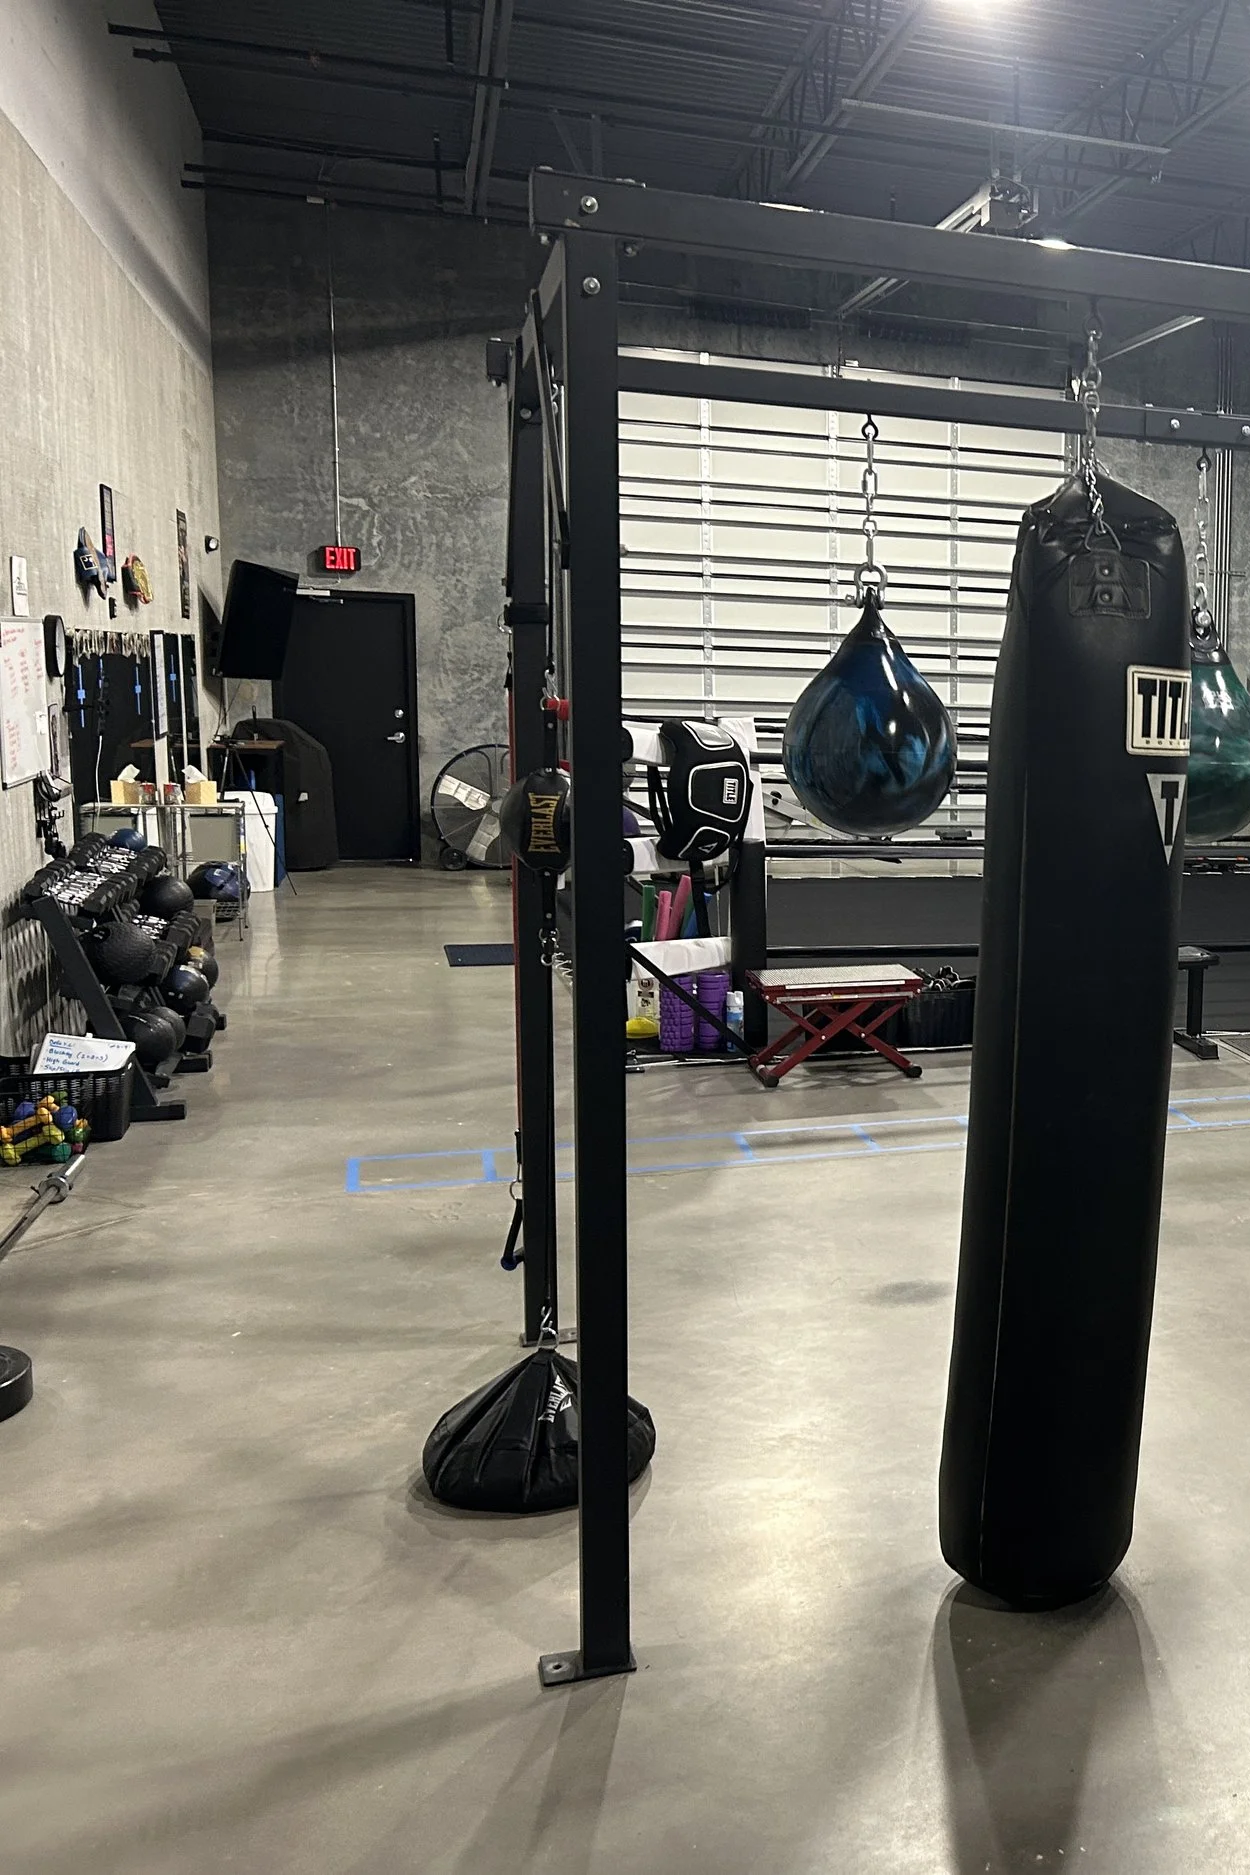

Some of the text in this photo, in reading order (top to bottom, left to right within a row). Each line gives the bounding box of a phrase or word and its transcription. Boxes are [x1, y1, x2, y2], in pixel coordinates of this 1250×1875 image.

[325, 547, 356, 570] EXIT
[1137, 677, 1190, 740] TITL
[528, 791, 562, 854] EVERLAST
[725, 781, 736, 802] TITLE
[1161, 780, 1179, 846] T
